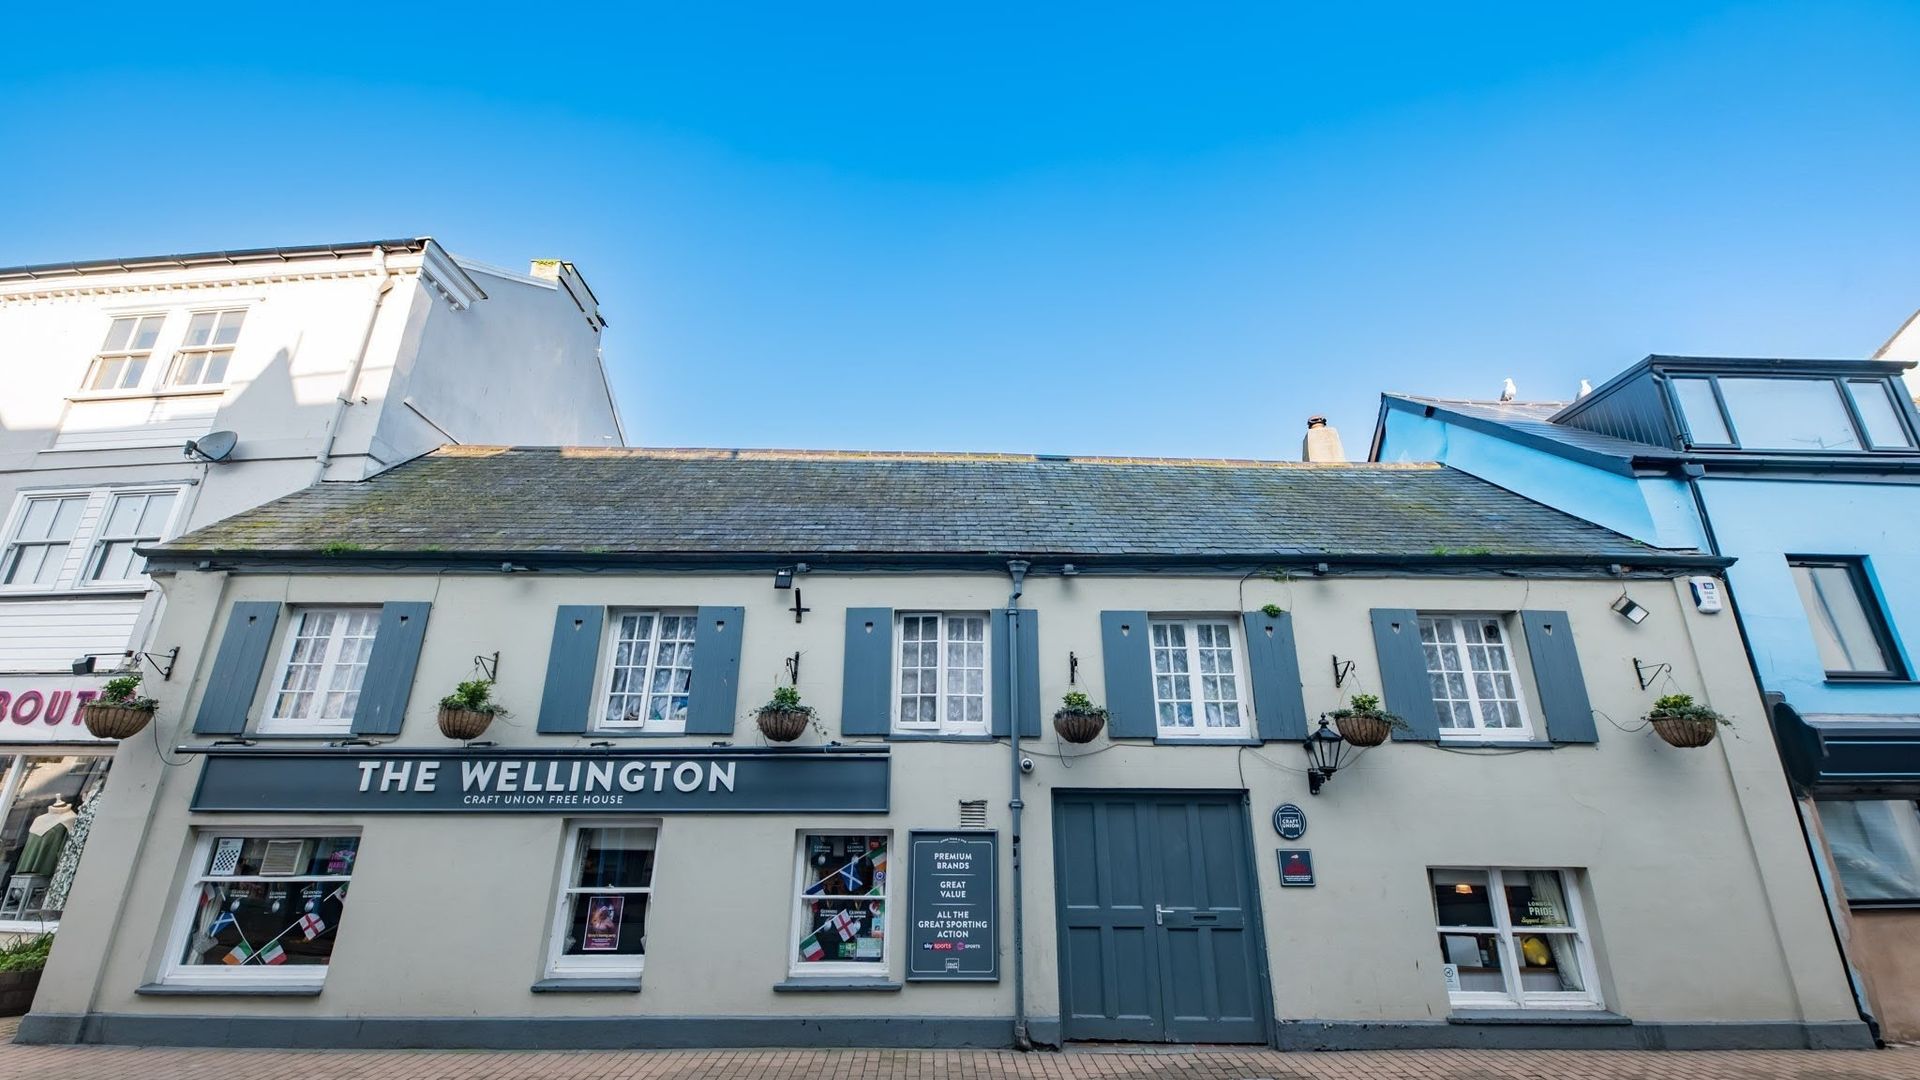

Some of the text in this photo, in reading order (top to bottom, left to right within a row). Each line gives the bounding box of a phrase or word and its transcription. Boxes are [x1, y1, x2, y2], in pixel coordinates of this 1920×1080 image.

[358, 761, 736, 792] THE WELLINGTON
[463, 795, 624, 804] CRAFT UNION FREE HOUSE
[934, 852, 973, 860] PREMIUM
[936, 862, 970, 870] BRANDS
[940, 881, 967, 889] GREAT
[940, 890, 967, 898] VALUE
[936, 911, 969, 919] ALL THE
[1528, 907, 1555, 916] PRIDE
[918, 920, 988, 928] GREAT SPORTING
[936, 930, 969, 938] ACTION
